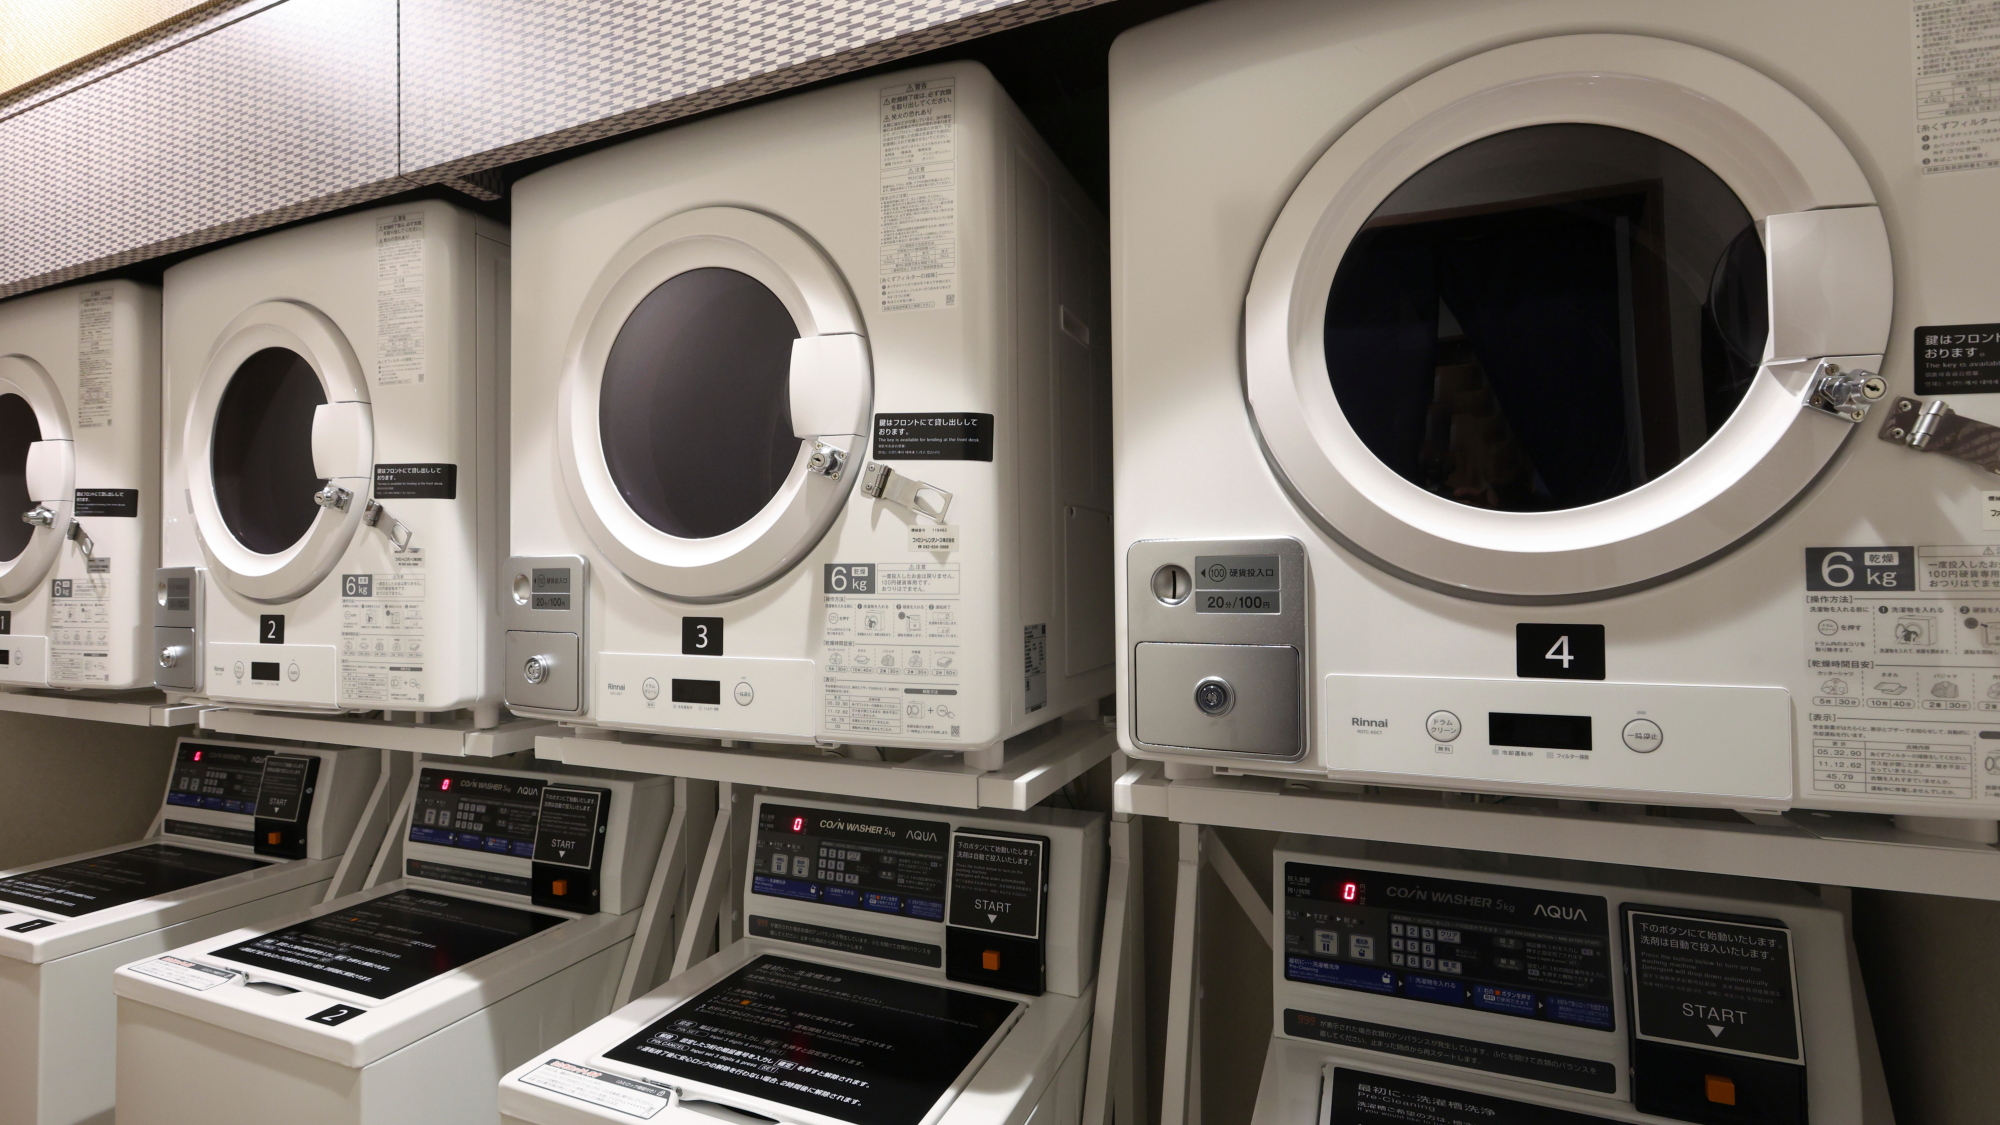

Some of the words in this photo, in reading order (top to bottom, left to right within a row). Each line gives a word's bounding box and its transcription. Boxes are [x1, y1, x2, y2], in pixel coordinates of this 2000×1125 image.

[1925, 347, 1985, 359] おります。
[1869, 554, 1895, 564] 乾燥
[1928, 561, 2000, 569] 一度投入したお
[1229, 569, 1274, 577] 硬貨投入口
[1821, 551, 1854, 587] 6
[831, 566, 848, 592] 6
[852, 578, 867, 592] kg
[1867, 569, 1897, 587] kg
[54, 581, 62, 597] 6
[346, 576, 356, 595] 6
[358, 586, 368, 596] kg
[267, 620, 276, 639] 2
[695, 624, 709, 649] 3
[1544, 635, 1575, 668] 4
[608, 683, 626, 691] Rinnai
[1352, 717, 1388, 728] Rinnai
[1431, 726, 1457, 734] クリーン
[517, 786, 538, 797] AQUA
[269, 798, 287, 807] START
[793, 818, 803, 831] 0
[819, 818, 845, 830] COIN
[846, 823, 882, 835] WASHER
[883, 827, 896, 838] 5kg
[906, 830, 938, 842] AQUA
[551, 838, 576, 850] START
[958, 842, 1037, 857] 下のボタンにて始動いたします。
[1343, 883, 1356, 901] 0
[1386, 885, 1428, 901] COIN
[1432, 892, 1493, 909] WASHER
[1495, 899, 1516, 913] 5kg
[975, 899, 1012, 914] START
[1533, 904, 1588, 922] AQUA
[1639, 922, 1783, 949] 下のボタンにて始動いたします。
[1640, 935, 1775, 961] 洗剤は自動で投入いたします。
[1641, 958, 1668, 967] washing
[1695, 958, 1714, 966] below
[1642, 964, 1674, 974] Detergent
[1688, 970, 1703, 978] drop
[1415, 977, 1456, 989] 洗濯物を入れる
[321, 1009, 348, 1022] 2
[1682, 1003, 1748, 1025] START
[1358, 1091, 1436, 1113] Pre-Cleaning
